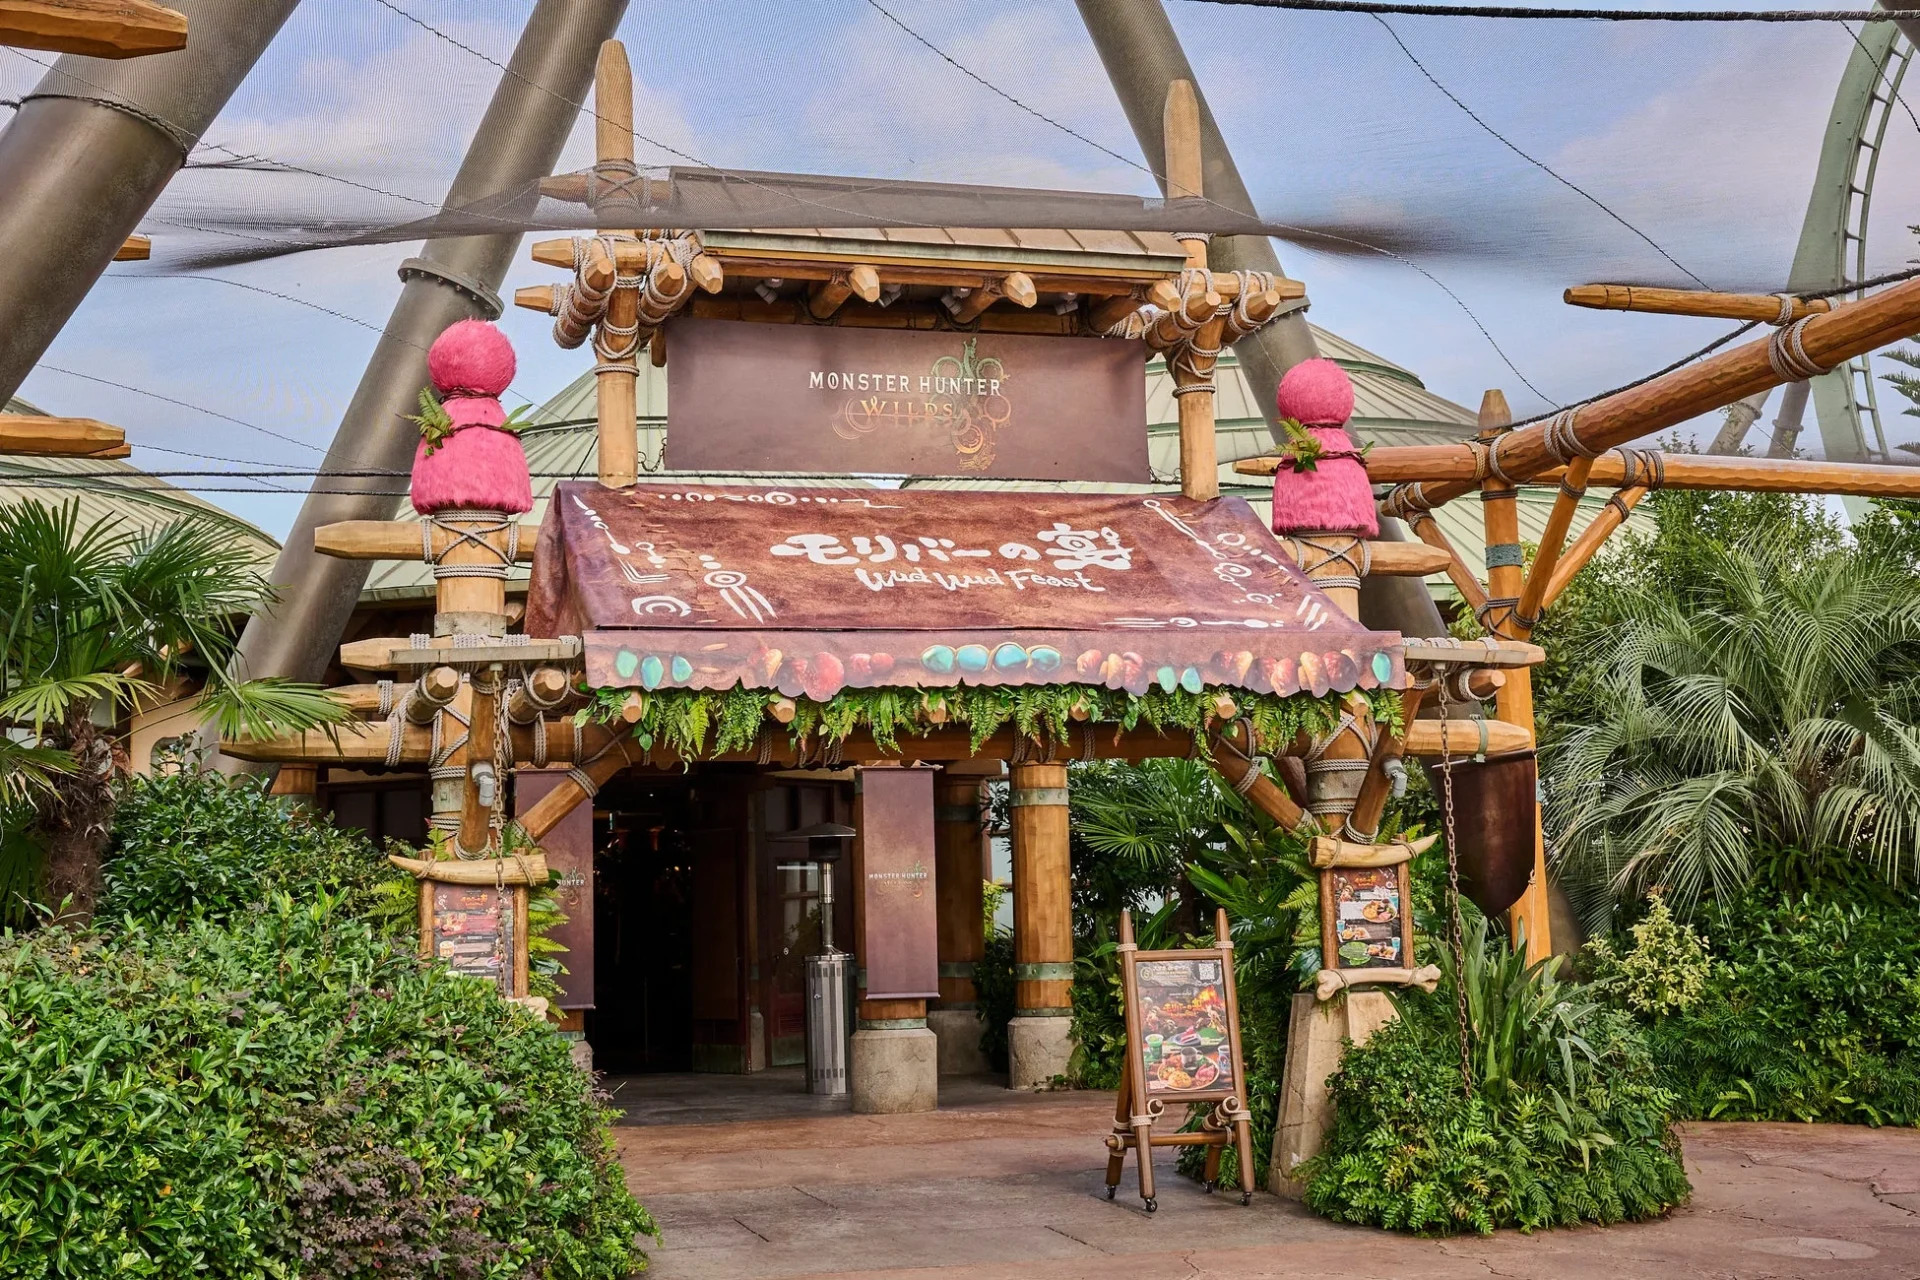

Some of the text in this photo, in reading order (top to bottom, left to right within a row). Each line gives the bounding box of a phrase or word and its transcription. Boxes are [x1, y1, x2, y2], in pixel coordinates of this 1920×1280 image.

[808, 371, 1001, 397] MONSTER HUNTER
[860, 395, 953, 417] WILDS
[854, 567, 1107, 592] Wud Wud Feast
[868, 872, 899, 880] MONSTER
